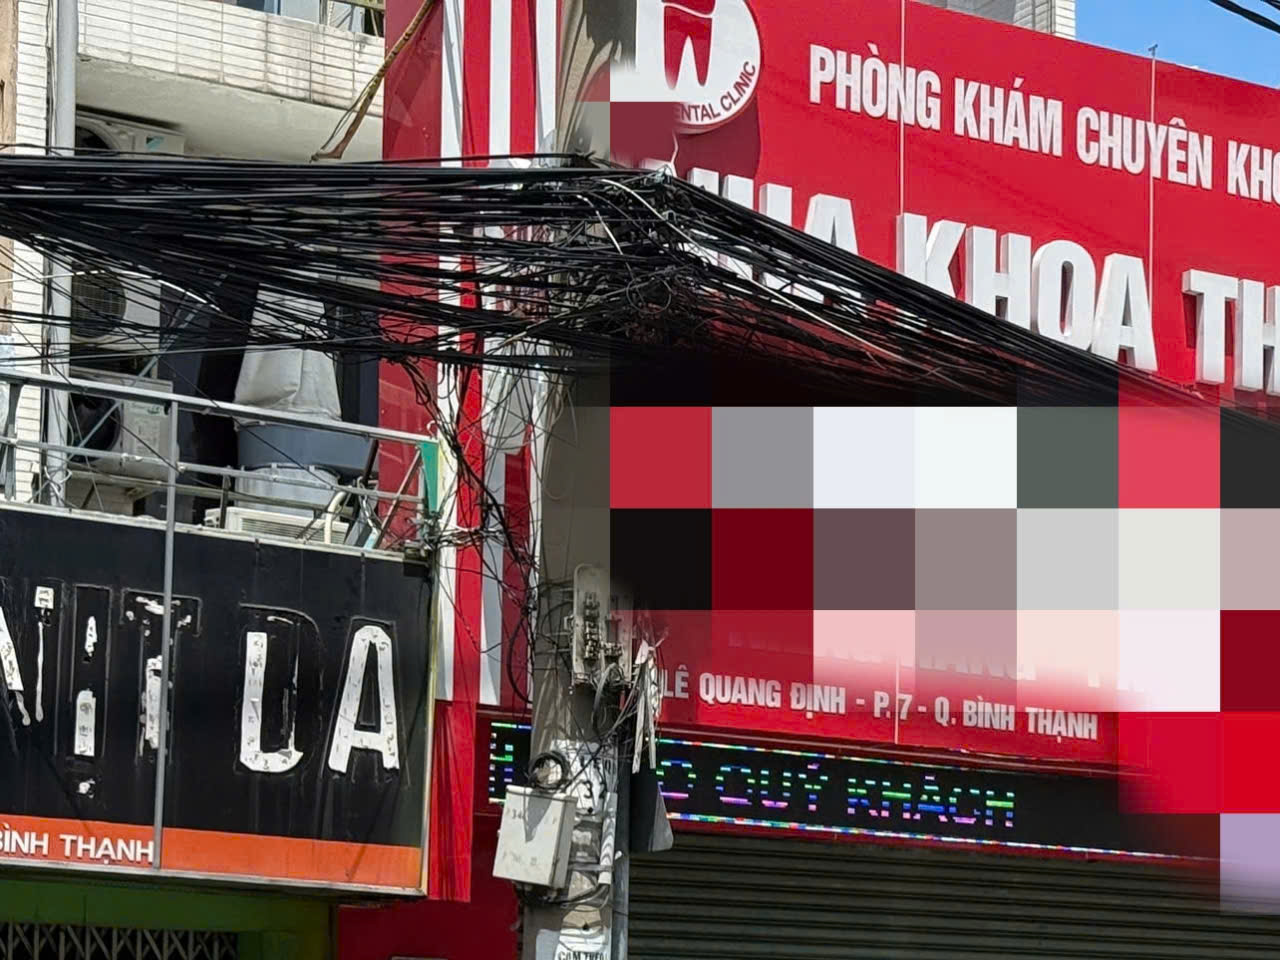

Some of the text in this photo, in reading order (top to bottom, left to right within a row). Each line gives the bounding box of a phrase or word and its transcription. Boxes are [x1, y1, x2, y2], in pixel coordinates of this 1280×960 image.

[720, 61, 756, 112] CLINIC
[809, 42, 942, 131] PHÒNG
[954, 76, 1063, 158] KHÁM
[1076, 105, 1213, 190] CHUYÊN
[896, 212, 1160, 373] KHOA
[699, 671, 782, 709] QUANG
[790, 681, 846, 719] ĐỊNH
[934, 696, 956, 726] Q.
[962, 695, 1015, 732] BÌNH
[1025, 706, 1098, 743] THẠNH
[59, 834, 155, 864] THẠNH
